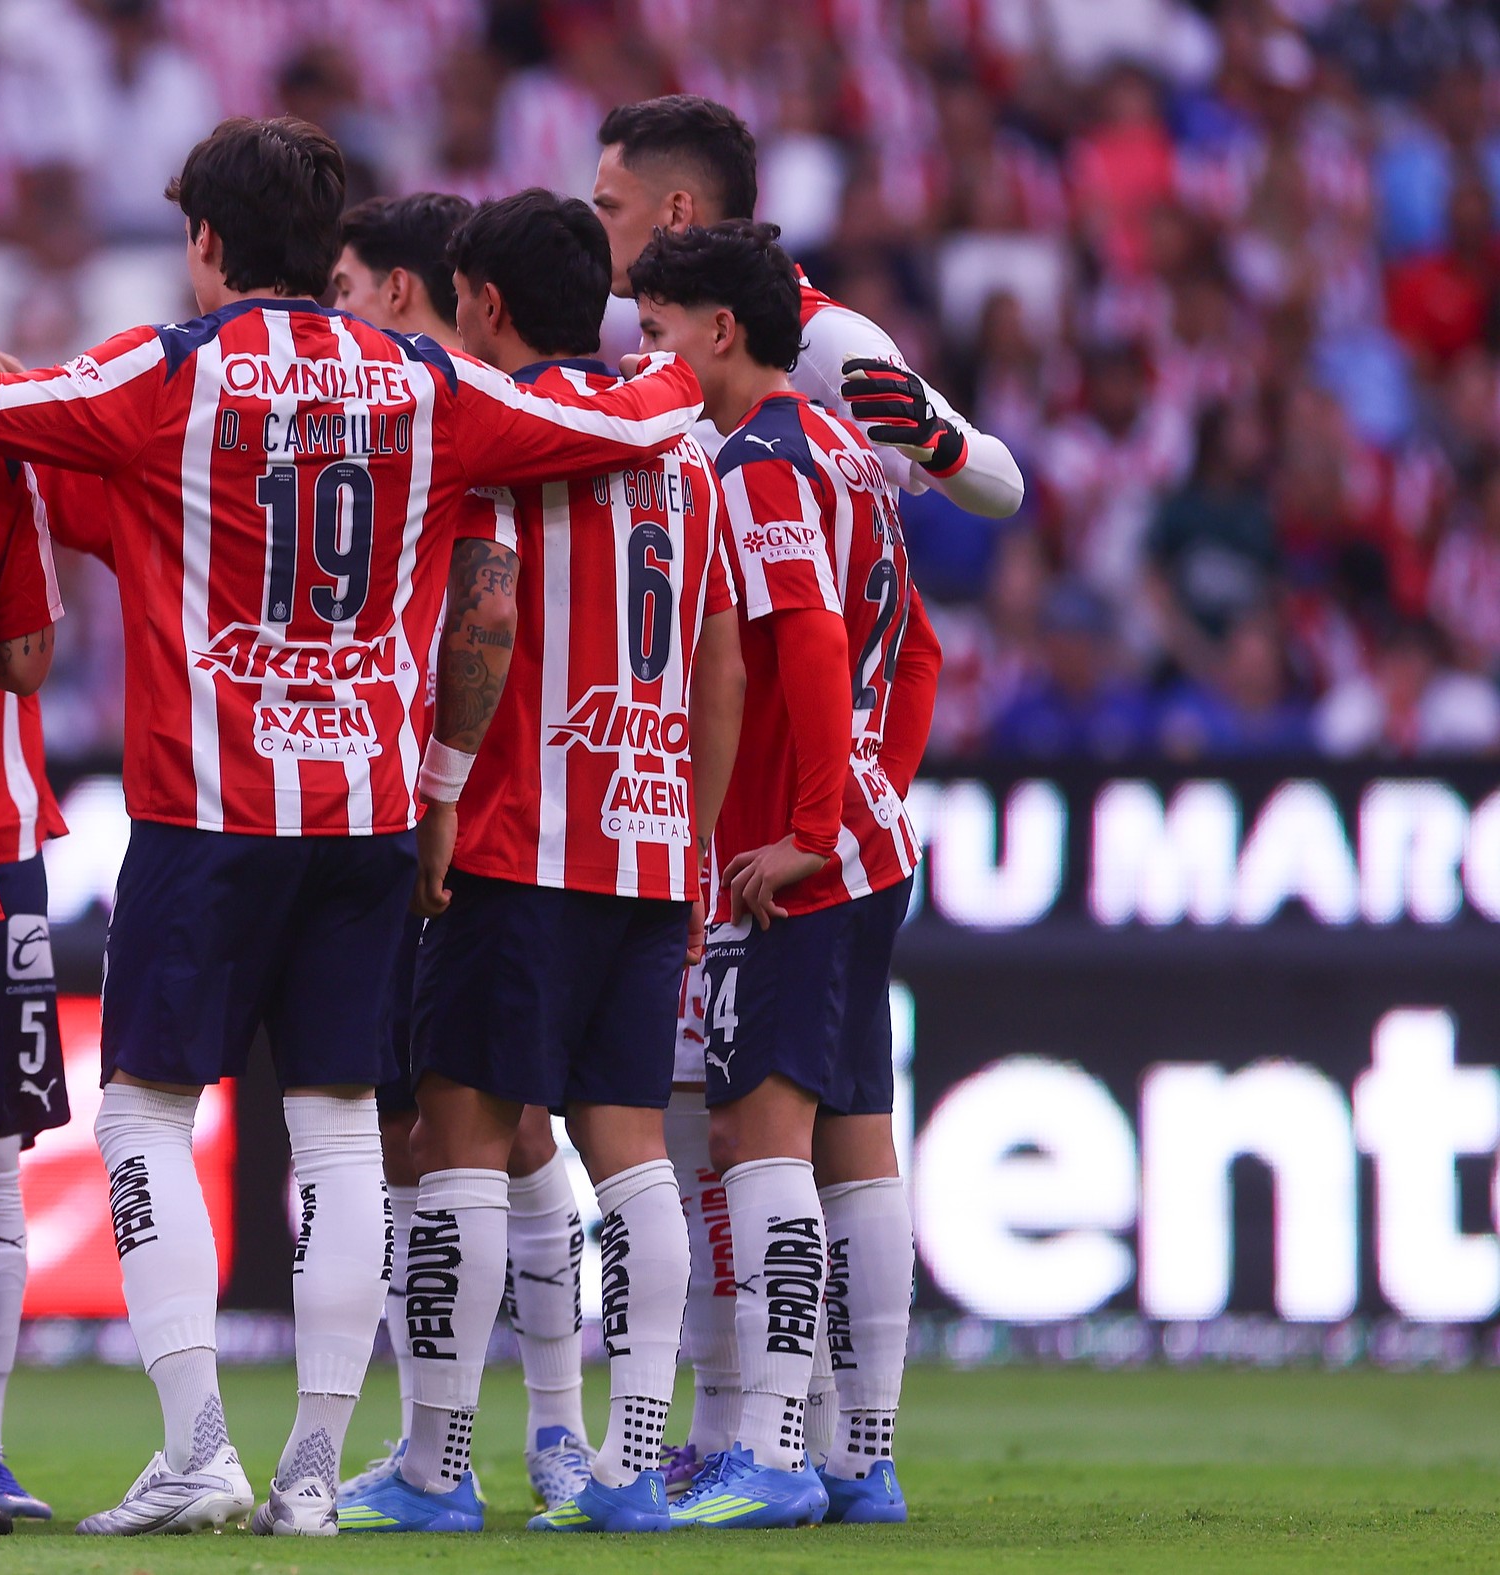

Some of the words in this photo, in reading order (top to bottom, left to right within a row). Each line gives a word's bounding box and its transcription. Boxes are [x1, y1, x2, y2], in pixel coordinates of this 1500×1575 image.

[226, 358, 404, 402] OMNILIFE
[219, 408, 248, 451] D.
[263, 412, 411, 455] CAMPILLO
[622, 468, 696, 517] GOVEA
[255, 461, 376, 625] 19
[766, 526, 816, 547] GNP
[627, 520, 676, 685] 6
[192, 628, 396, 680] AKRON
[260, 706, 370, 739] AXEN
[261, 737, 376, 755] CAPITAL
[546, 691, 690, 755] AKRO
[608, 776, 687, 819] AXEN
[608, 817, 689, 840] CAPITAL
[18, 1000, 48, 1075] 5
[109, 1154, 159, 1262] PERDURA
[406, 1209, 464, 1361] PERDURA
[763, 1217, 824, 1359] PERDURA
[826, 1237, 858, 1372] PERDURA
